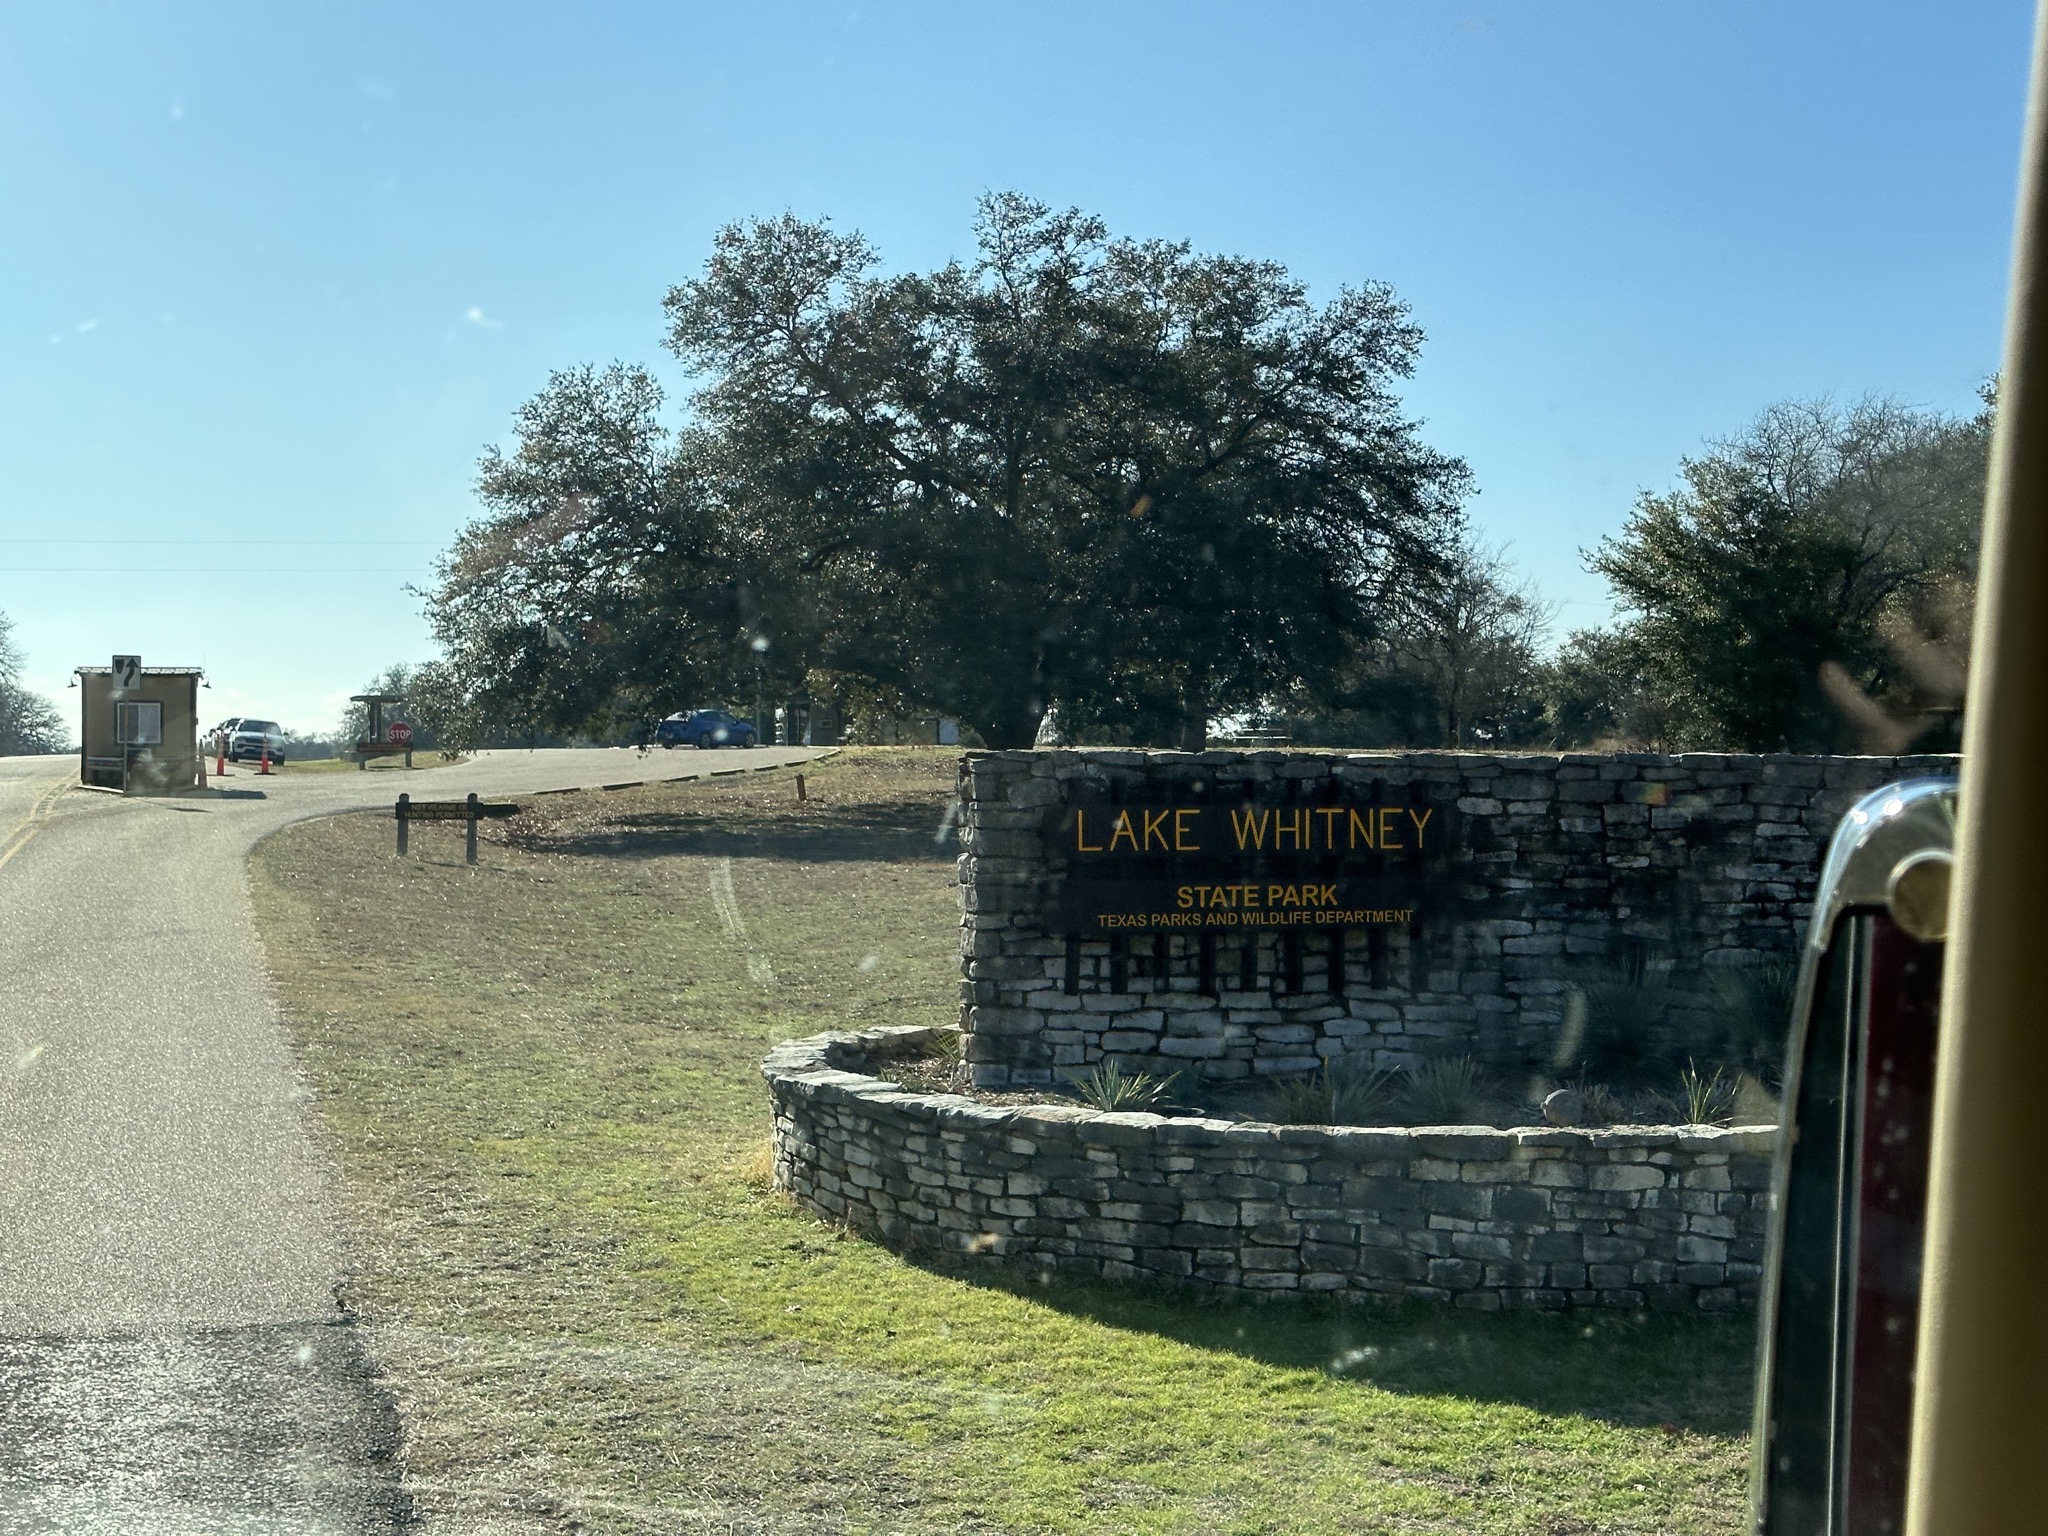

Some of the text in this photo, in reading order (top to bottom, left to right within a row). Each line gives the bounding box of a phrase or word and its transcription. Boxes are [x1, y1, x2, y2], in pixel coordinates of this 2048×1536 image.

[389, 729, 412, 739] STOP
[1077, 807, 1433, 853] LAKE WHITNEY
[1177, 884, 1338, 909] STATE PARK
[1098, 910, 1413, 928] TEXAS PARKS AND WILDLIFE DEPARTMENT
